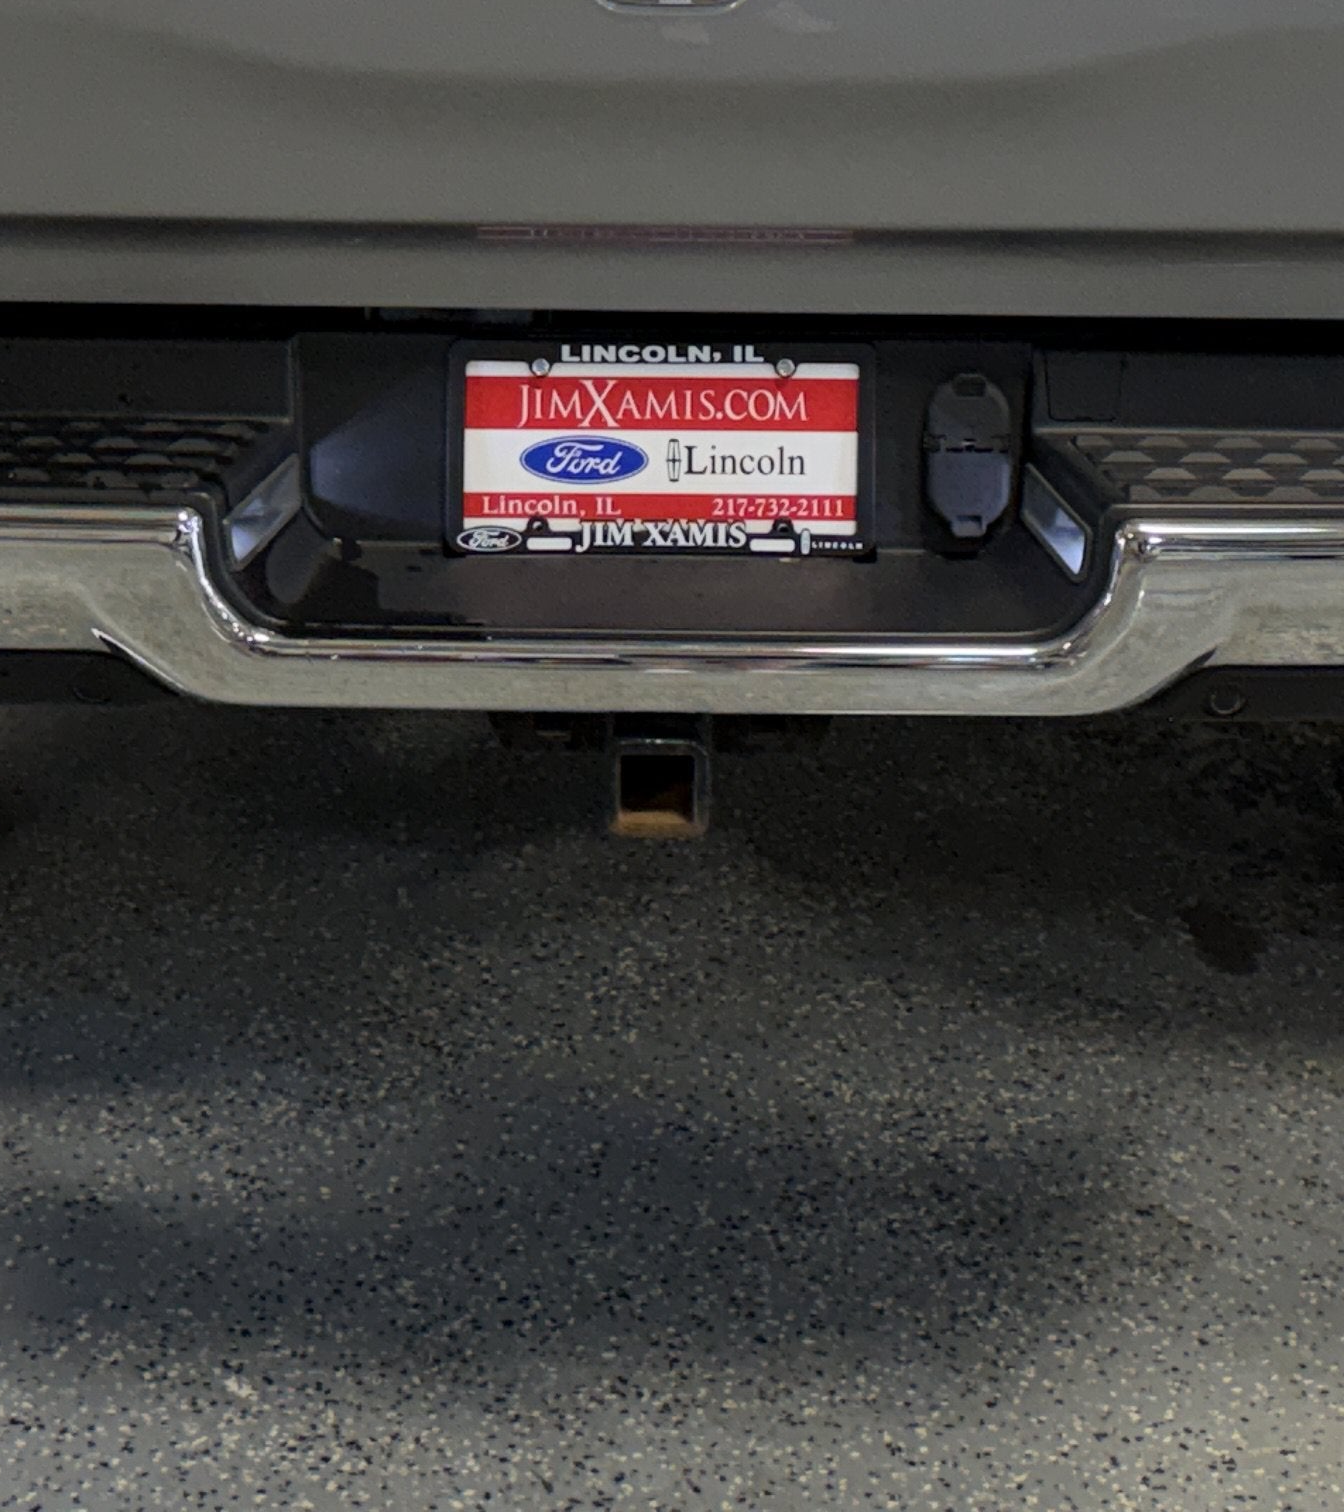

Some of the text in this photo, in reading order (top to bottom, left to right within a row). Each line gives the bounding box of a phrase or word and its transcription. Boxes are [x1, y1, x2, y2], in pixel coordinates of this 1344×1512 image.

[560, 344, 766, 364] LINCOLN, IL
[517, 379, 808, 428] JIMXAMIS.COM
[545, 441, 622, 476] Ford
[684, 444, 806, 477] Lincoln
[482, 496, 622, 517] Lincoln, IL
[711, 497, 844, 518] 217-732-2111
[575, 519, 748, 553] JIM XAMIS
